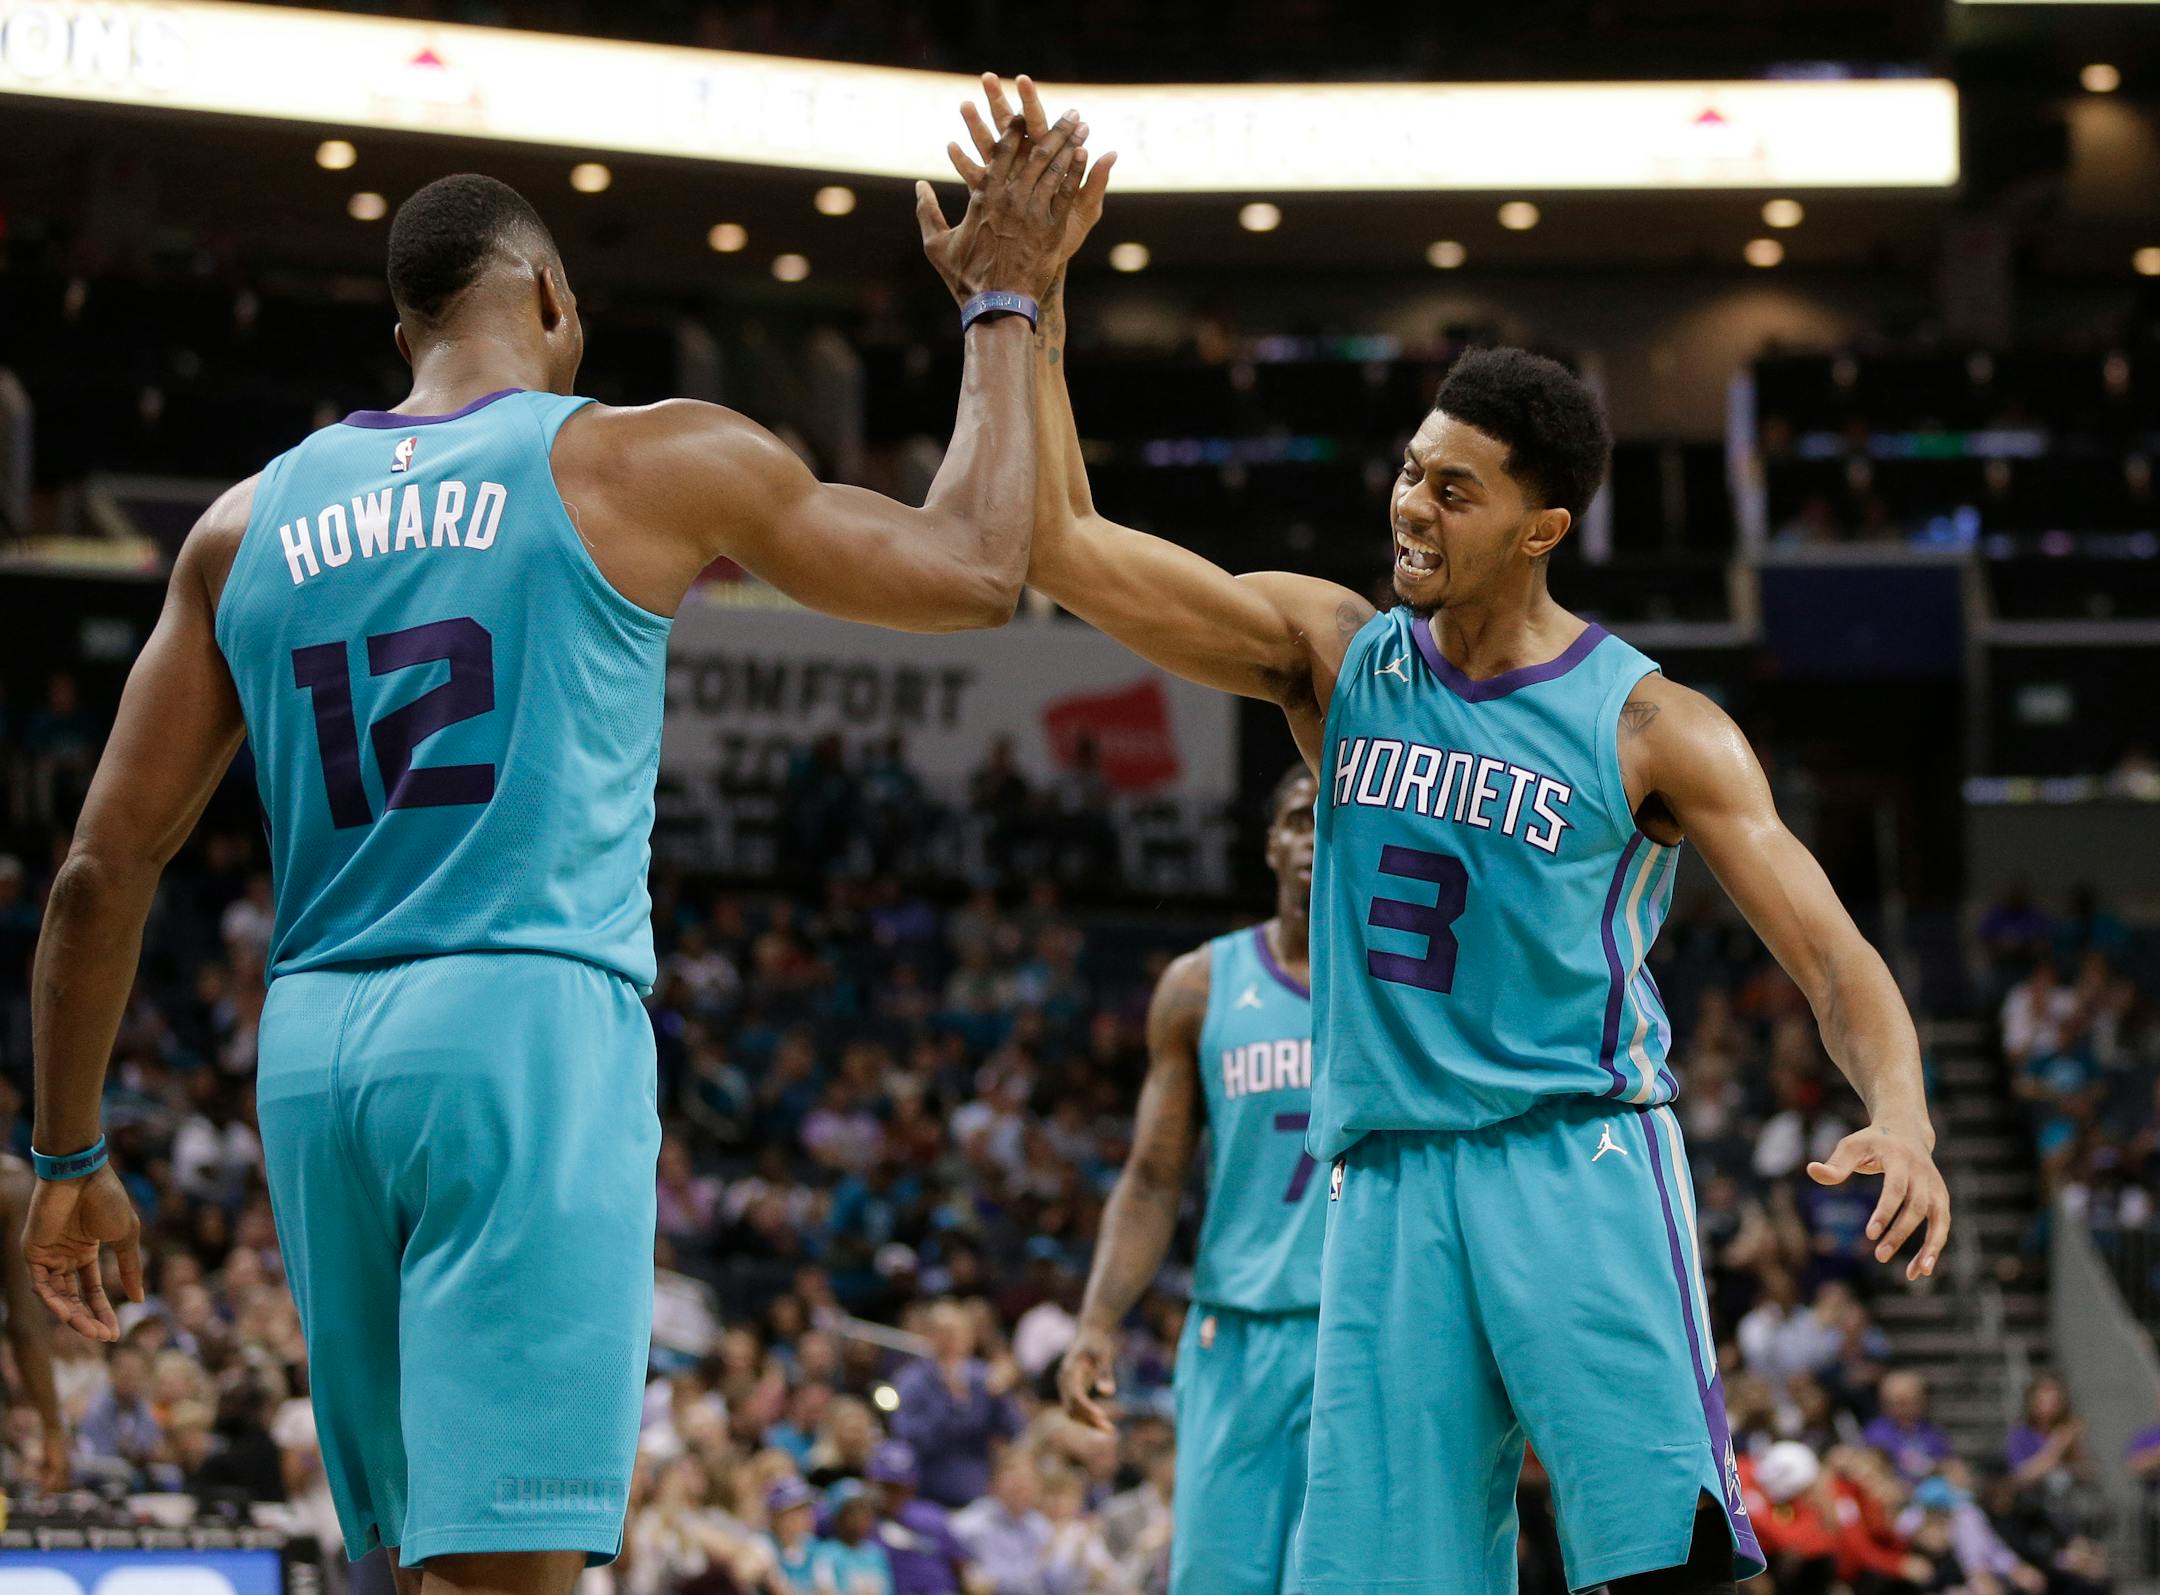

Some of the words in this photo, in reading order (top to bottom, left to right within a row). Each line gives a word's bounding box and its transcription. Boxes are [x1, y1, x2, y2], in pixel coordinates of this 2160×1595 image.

[279, 480, 508, 585] HOWARD
[291, 616, 496, 830] 12
[1333, 736, 1575, 856] HORNETS
[1367, 844, 1470, 995] 3
[1275, 1113, 1317, 1202] 7
